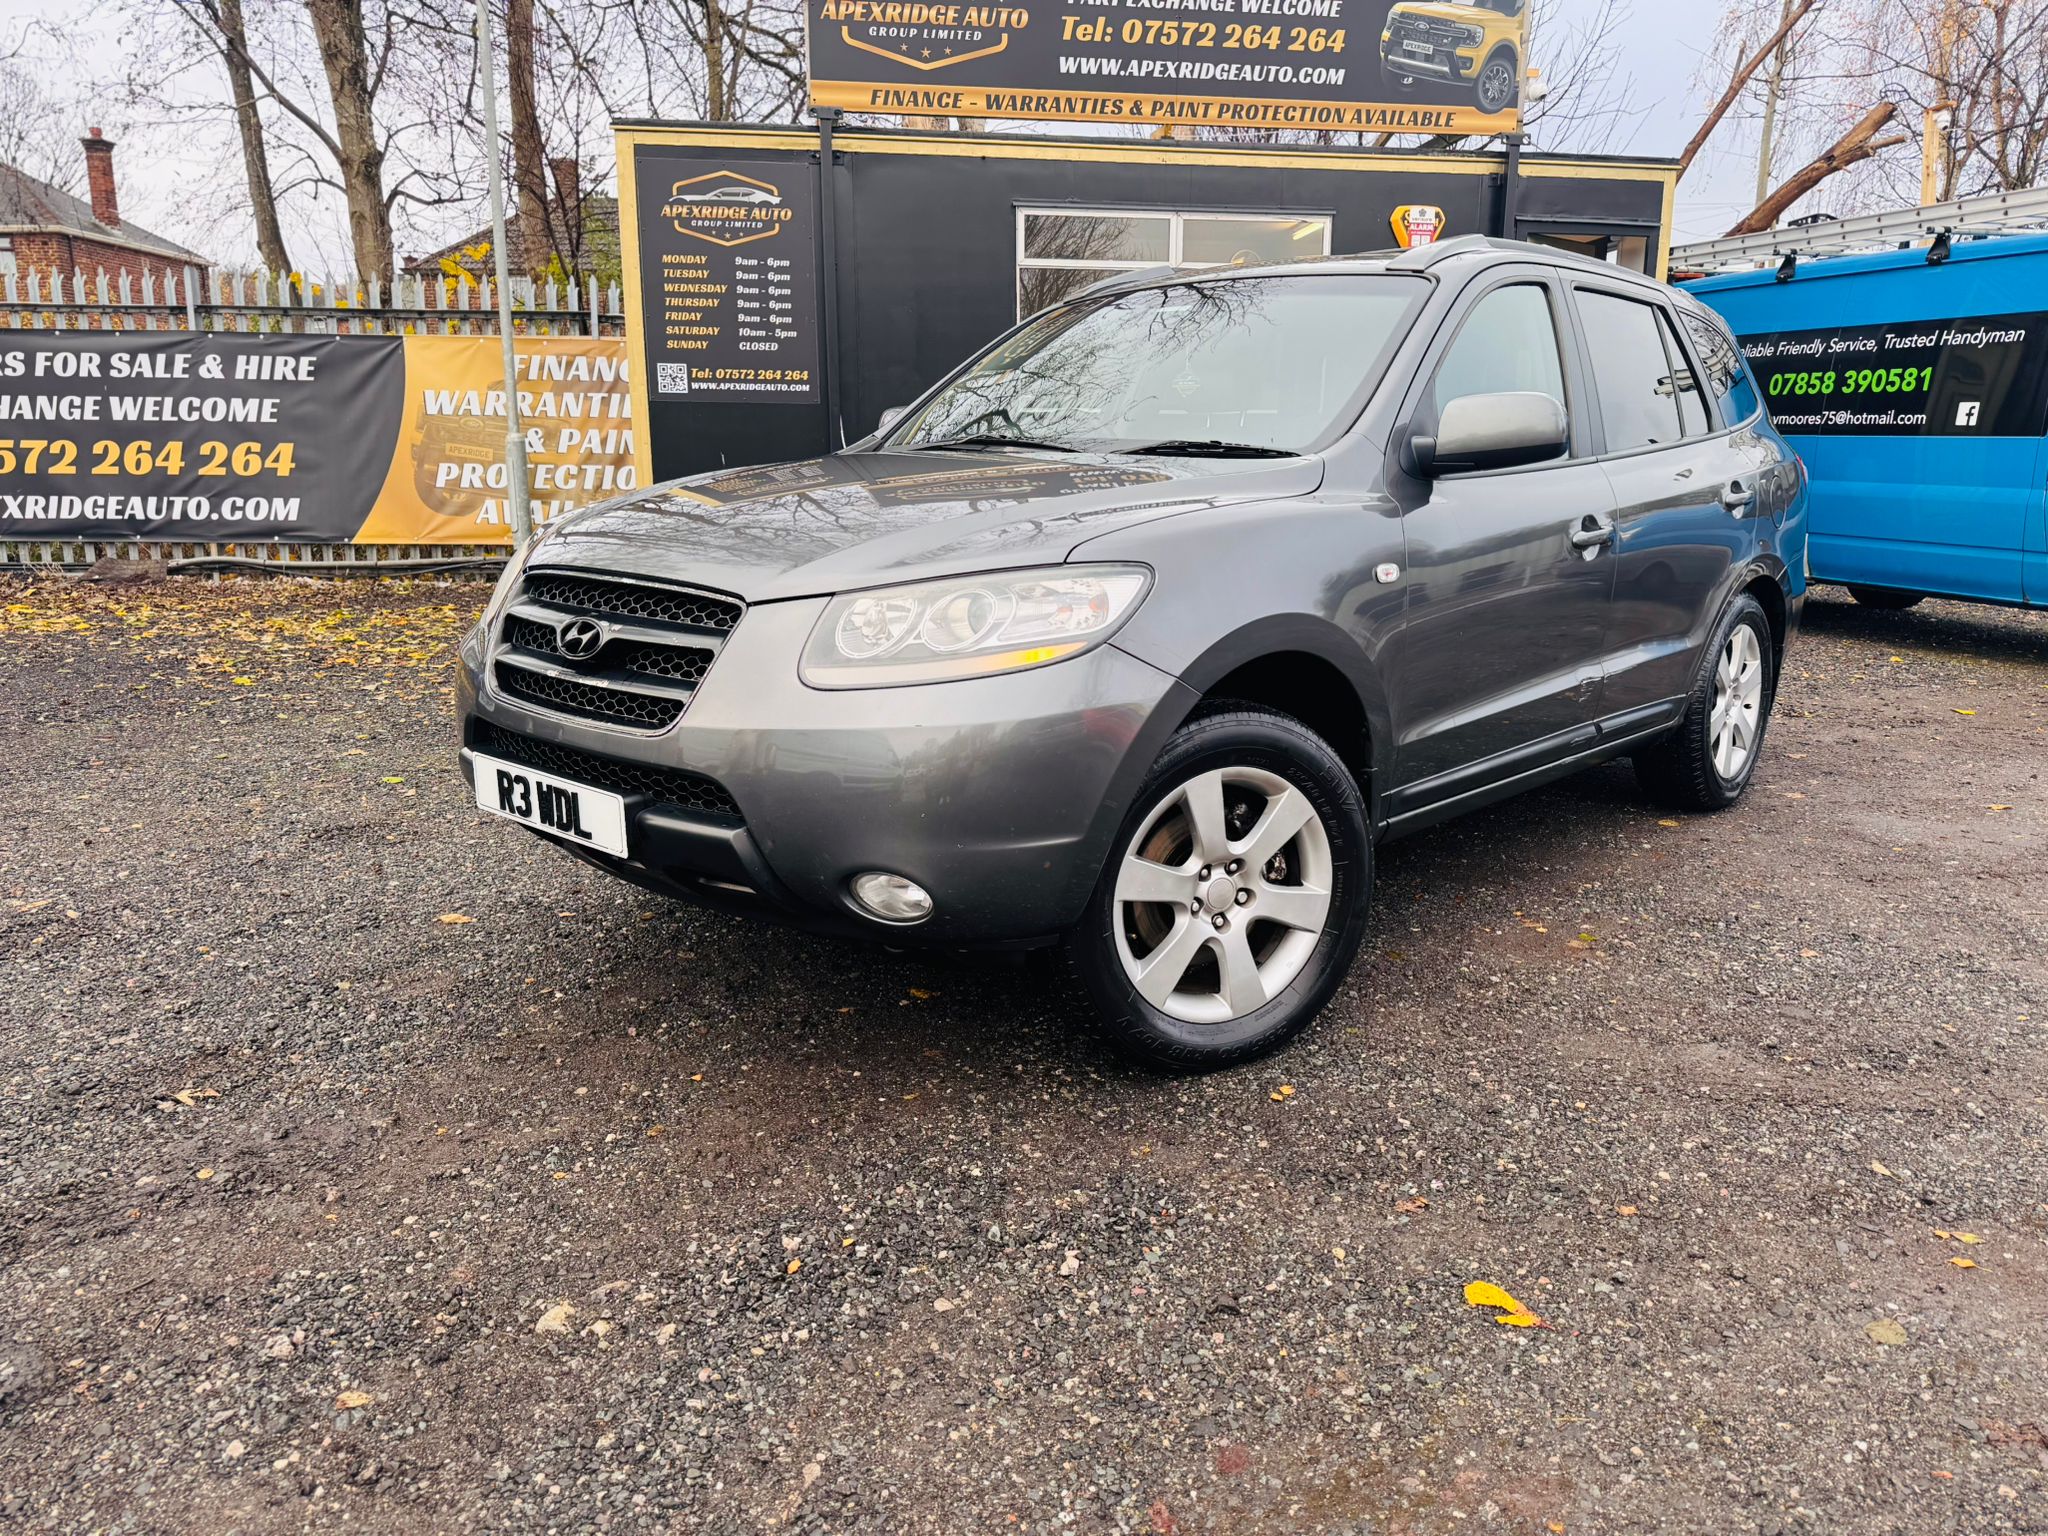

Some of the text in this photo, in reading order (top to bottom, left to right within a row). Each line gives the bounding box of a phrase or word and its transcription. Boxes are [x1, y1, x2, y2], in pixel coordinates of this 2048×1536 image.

[820, 0, 1029, 28] APEXRIDGE AUTO
[1241, 0, 1342, 18] WELCOME
[869, 26, 982, 41] GROUP LIMITED
[1061, 16, 1346, 52] Tel: 07572 264 264
[1059, 56, 1346, 86] WWW.APEXRIDGEAUTO.COM
[870, 89, 964, 108] FINANCE
[985, 94, 1124, 116] WARRANTIES
[1129, 100, 1143, 116] &
[1150, 101, 1213, 119] PAINT
[1217, 103, 1347, 124] PROTECTION
[1350, 108, 1457, 128] AVAILABLE
[661, 204, 792, 221] APEXRIDGE AUTO
[691, 220, 763, 229] GROUP LIMITED
[1410, 223, 1434, 231] ALARM
[662, 254, 708, 264] MONDAY
[735, 257, 758, 266] 9am
[767, 258, 790, 268] 6pm
[663, 269, 710, 278] TUESDAY
[736, 271, 758, 280] 9am
[768, 272, 790, 283] 6pm
[664, 283, 728, 293] WEDNESDAY
[736, 286, 759, 295] 9am
[768, 286, 791, 297] 6pm
[664, 298, 720, 307] THURSDAY
[737, 300, 760, 309] 9am
[769, 301, 792, 311] 6pm
[665, 312, 702, 321] FRIDAY
[738, 314, 760, 323] 9am
[769, 315, 792, 325] 6pm
[666, 326, 720, 335] SATURDAY
[738, 328, 766, 337] 10am
[775, 329, 797, 340] 5pm
[1777, 338, 1826, 357] Friendly
[1828, 337, 1878, 353] Service,
[1884, 330, 1938, 349] Trusted
[1941, 327, 2026, 349] Handyman
[667, 340, 778, 351] SUNDAY CLOSED
[0, 351, 318, 381] S FOR SALE & HIRE
[690, 368, 809, 380] Tel: 07572 264 264
[691, 382, 810, 392] WWW.APEXRIDGEAUTO.COM
[1769, 366, 1933, 396] 07858 390581
[109, 396, 280, 423] WELCOME
[525, 428, 545, 453] &
[91, 440, 185, 476] 264
[198, 441, 296, 477] 264
[436, 462, 636, 490] PROECTIO
[0, 495, 300, 521] XRIDGEAUTO.COM
[496, 769, 532, 818] R3
